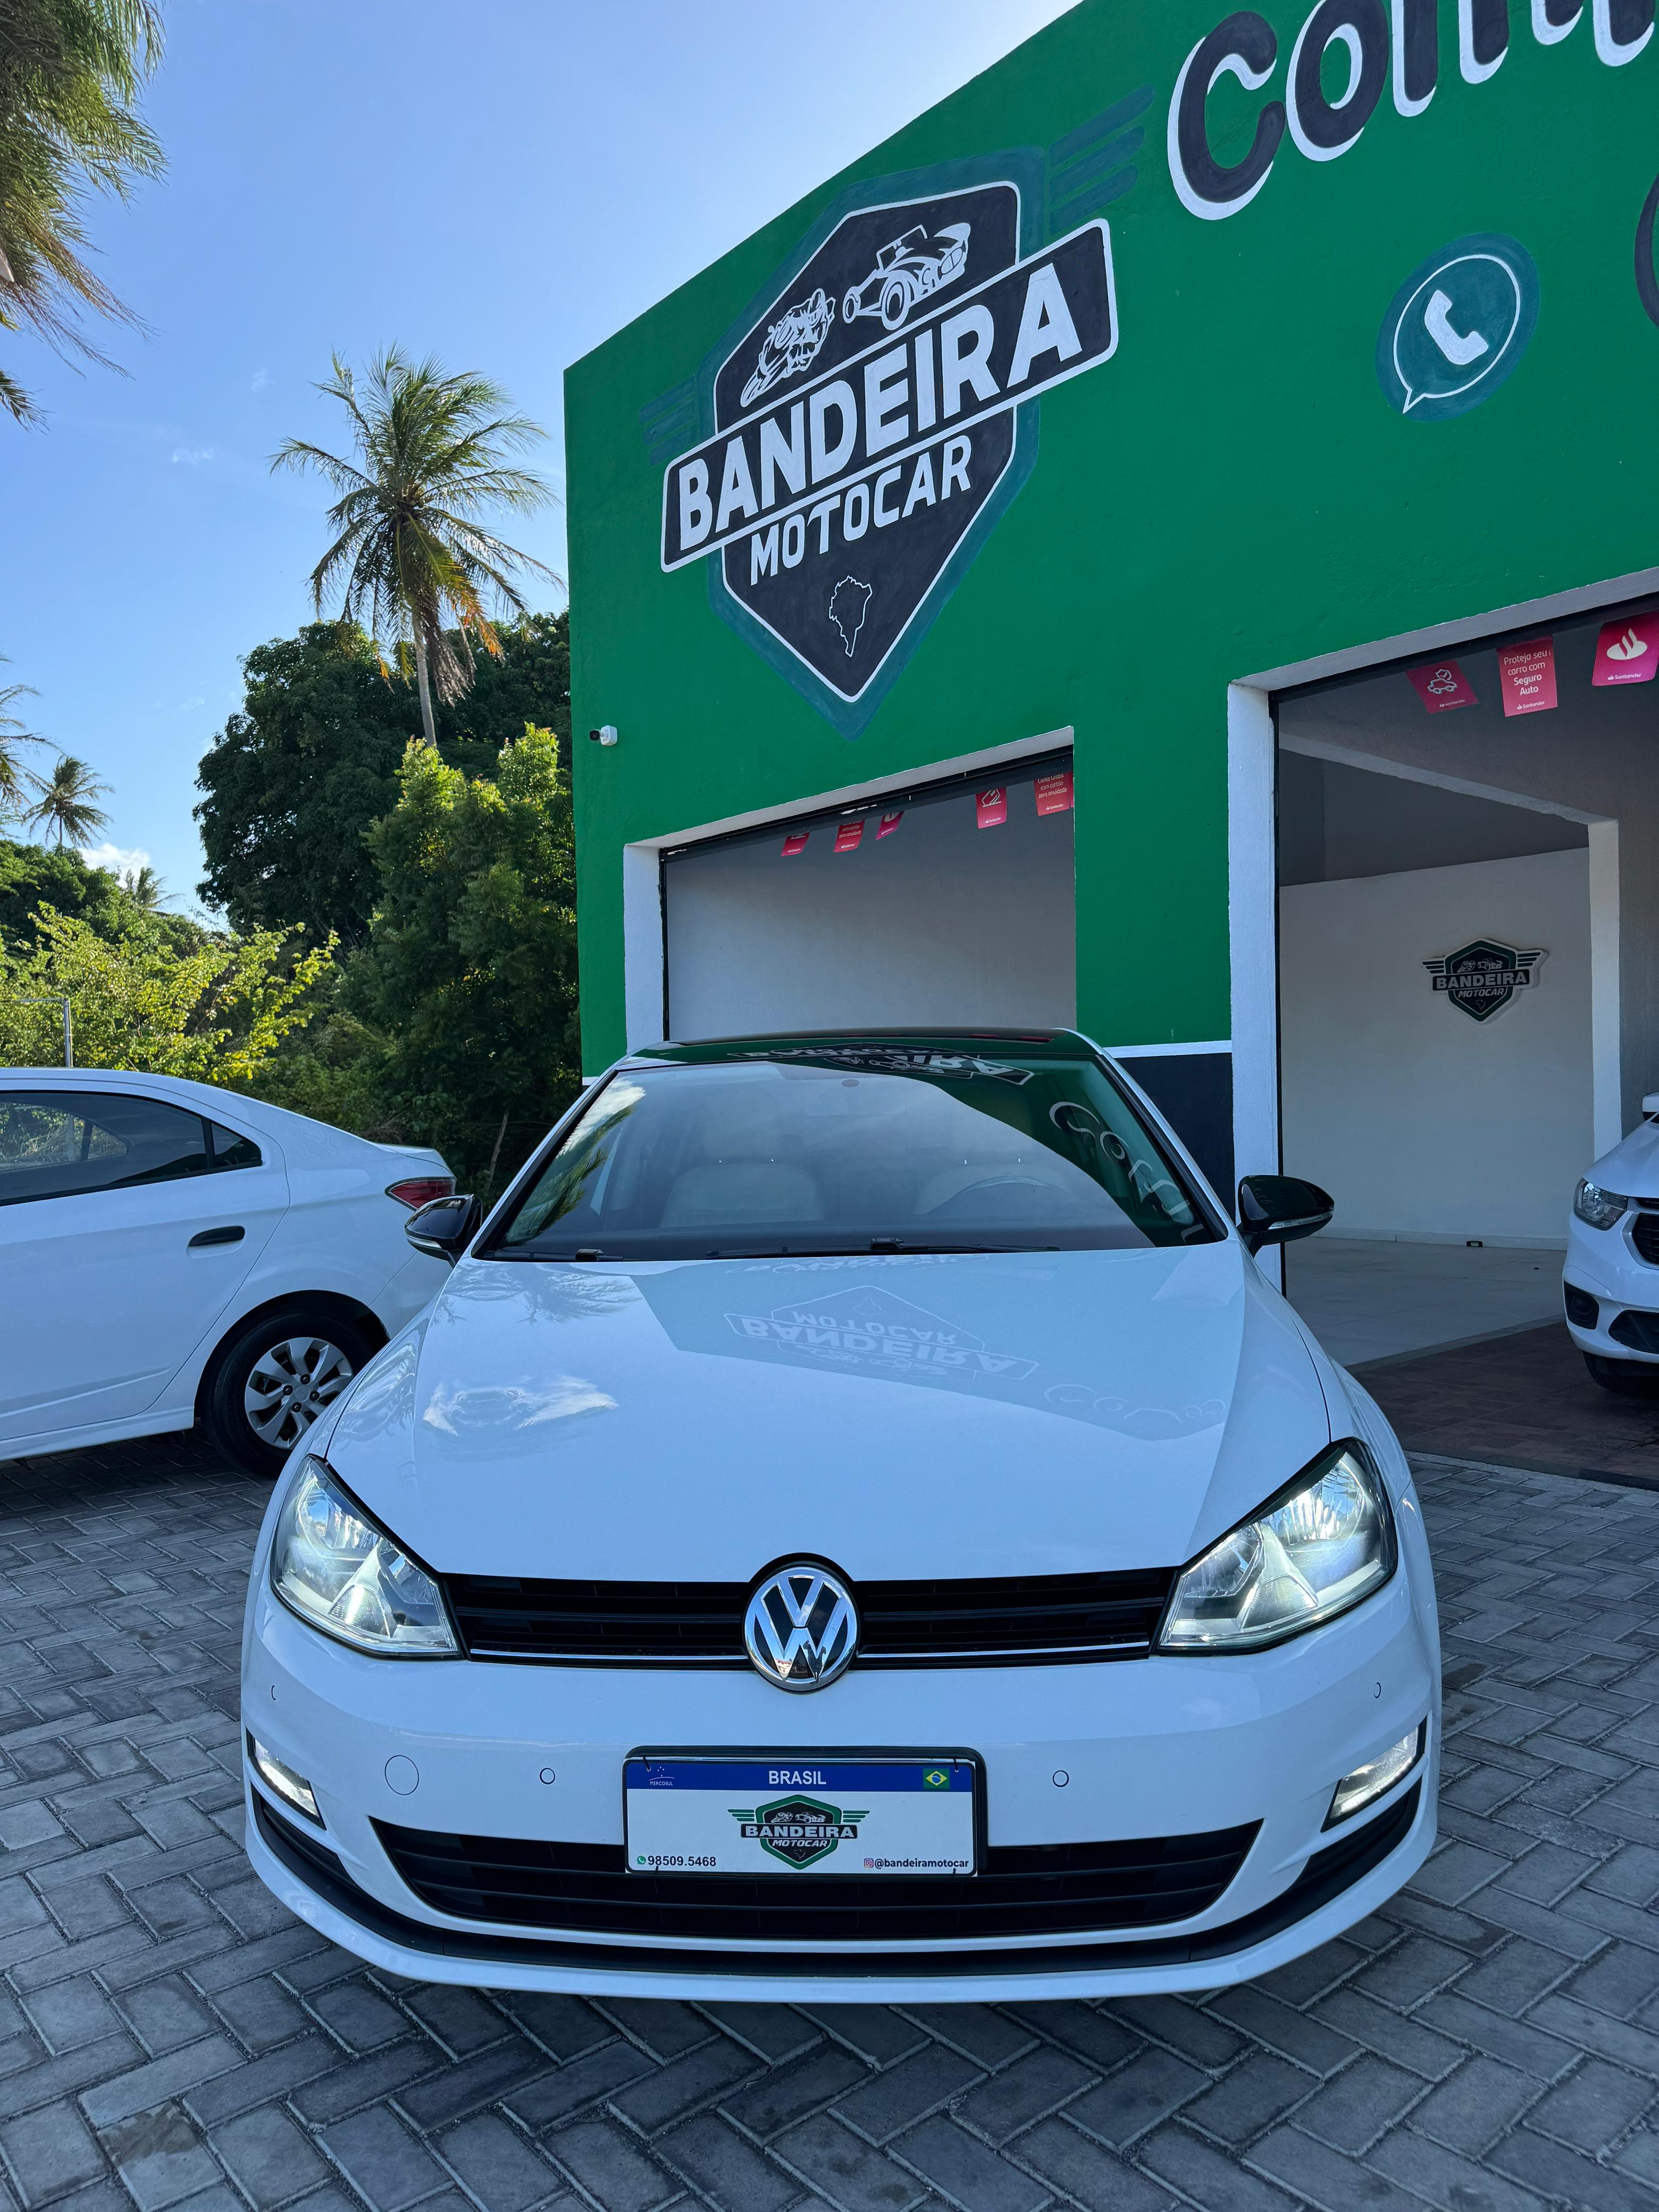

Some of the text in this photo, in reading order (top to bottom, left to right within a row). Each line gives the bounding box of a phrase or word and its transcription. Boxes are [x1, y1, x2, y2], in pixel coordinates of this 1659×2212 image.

[678, 263, 1083, 551] BANDEIRA
[750, 434, 972, 586] MOTOCAR
[1503, 650, 1547, 666] Proteja seu
[1507, 662, 1546, 676] carro com
[1513, 674, 1542, 686] Seguro
[1520, 686, 1539, 696] Auto
[1436, 971, 1527, 989] BANDEIRA
[1457, 988, 1504, 998] MOTOCAR
[768, 1770, 827, 1785] BRASIL
[745, 1825, 854, 1838] BANDEIRA
[648, 1855, 717, 1867] 98509.5468
[875, 1858, 969, 1869] @bandeiramotocar
